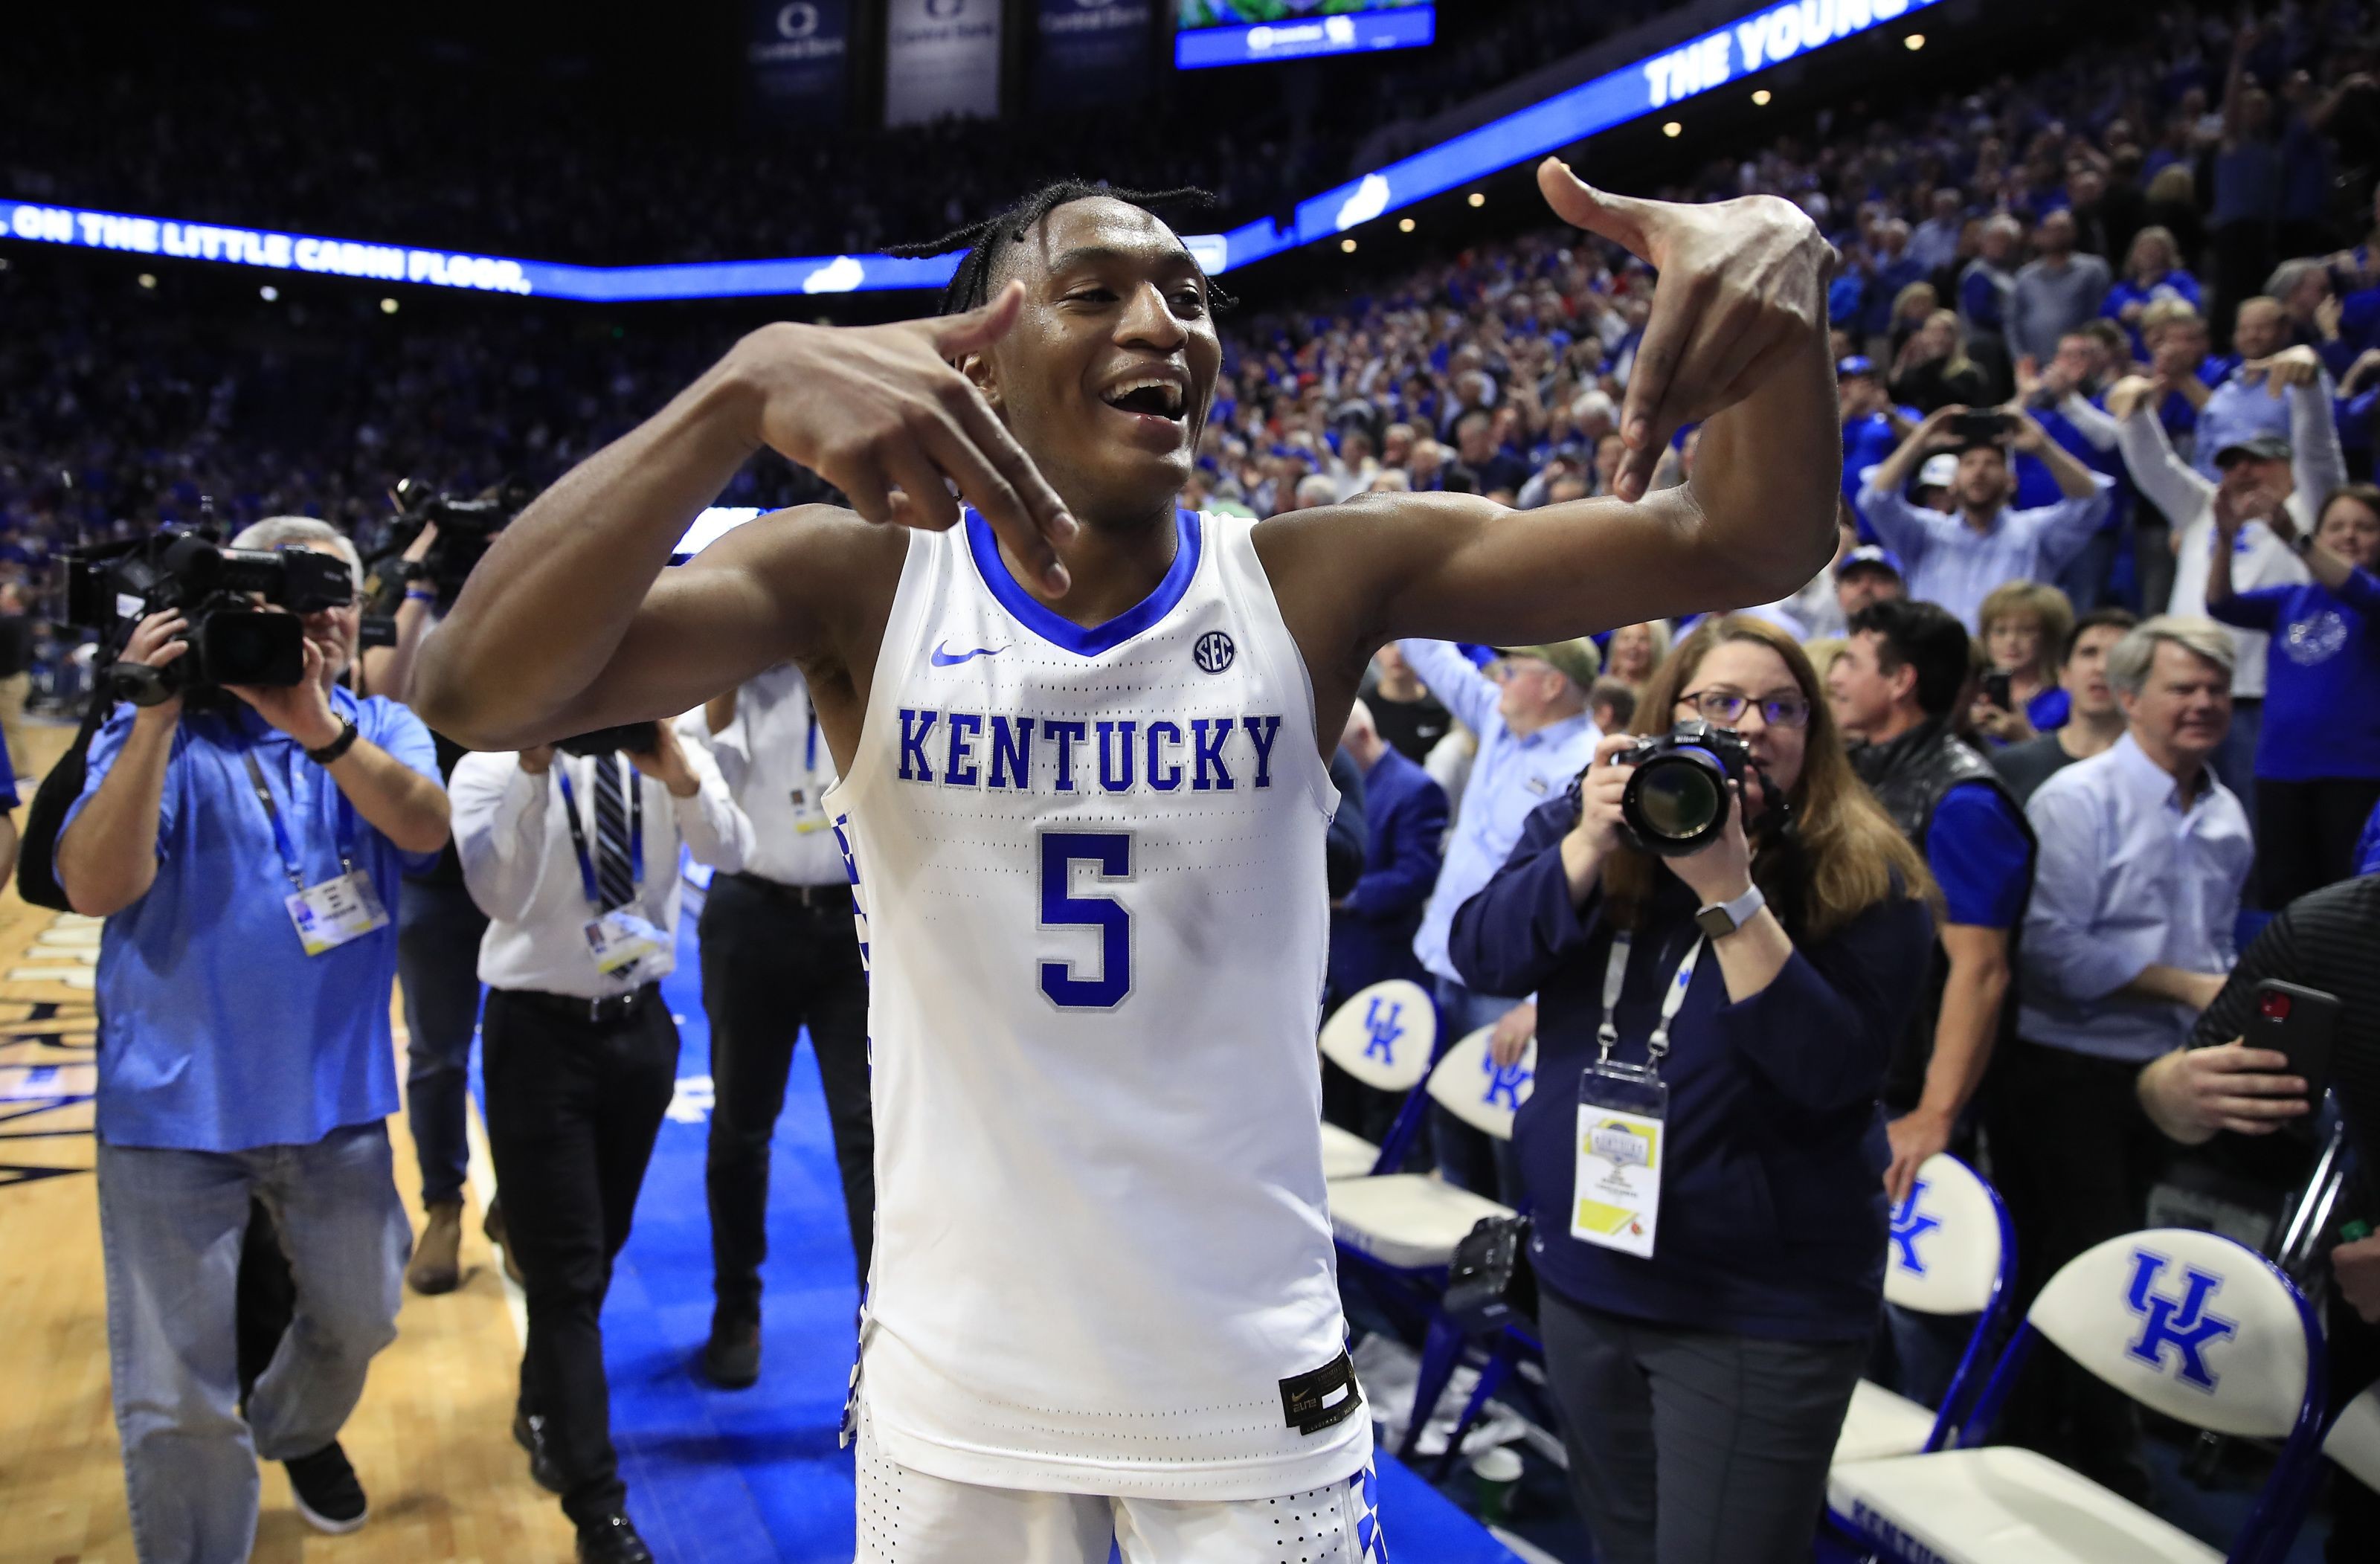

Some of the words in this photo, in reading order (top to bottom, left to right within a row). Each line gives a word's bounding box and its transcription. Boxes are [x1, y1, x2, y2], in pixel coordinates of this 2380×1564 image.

[1644, 30, 1731, 109] THE
[12, 205, 74, 243] ON
[77, 211, 159, 254] THE
[162, 222, 292, 268] LITTLE
[295, 237, 405, 281] CABIN
[1195, 634, 1232, 671] SEC
[896, 707, 1283, 795] KENTUCKY
[1675, 734, 1701, 744] Nikon
[1036, 826, 1136, 1014] 5
[2121, 1245, 2236, 1395] UK
